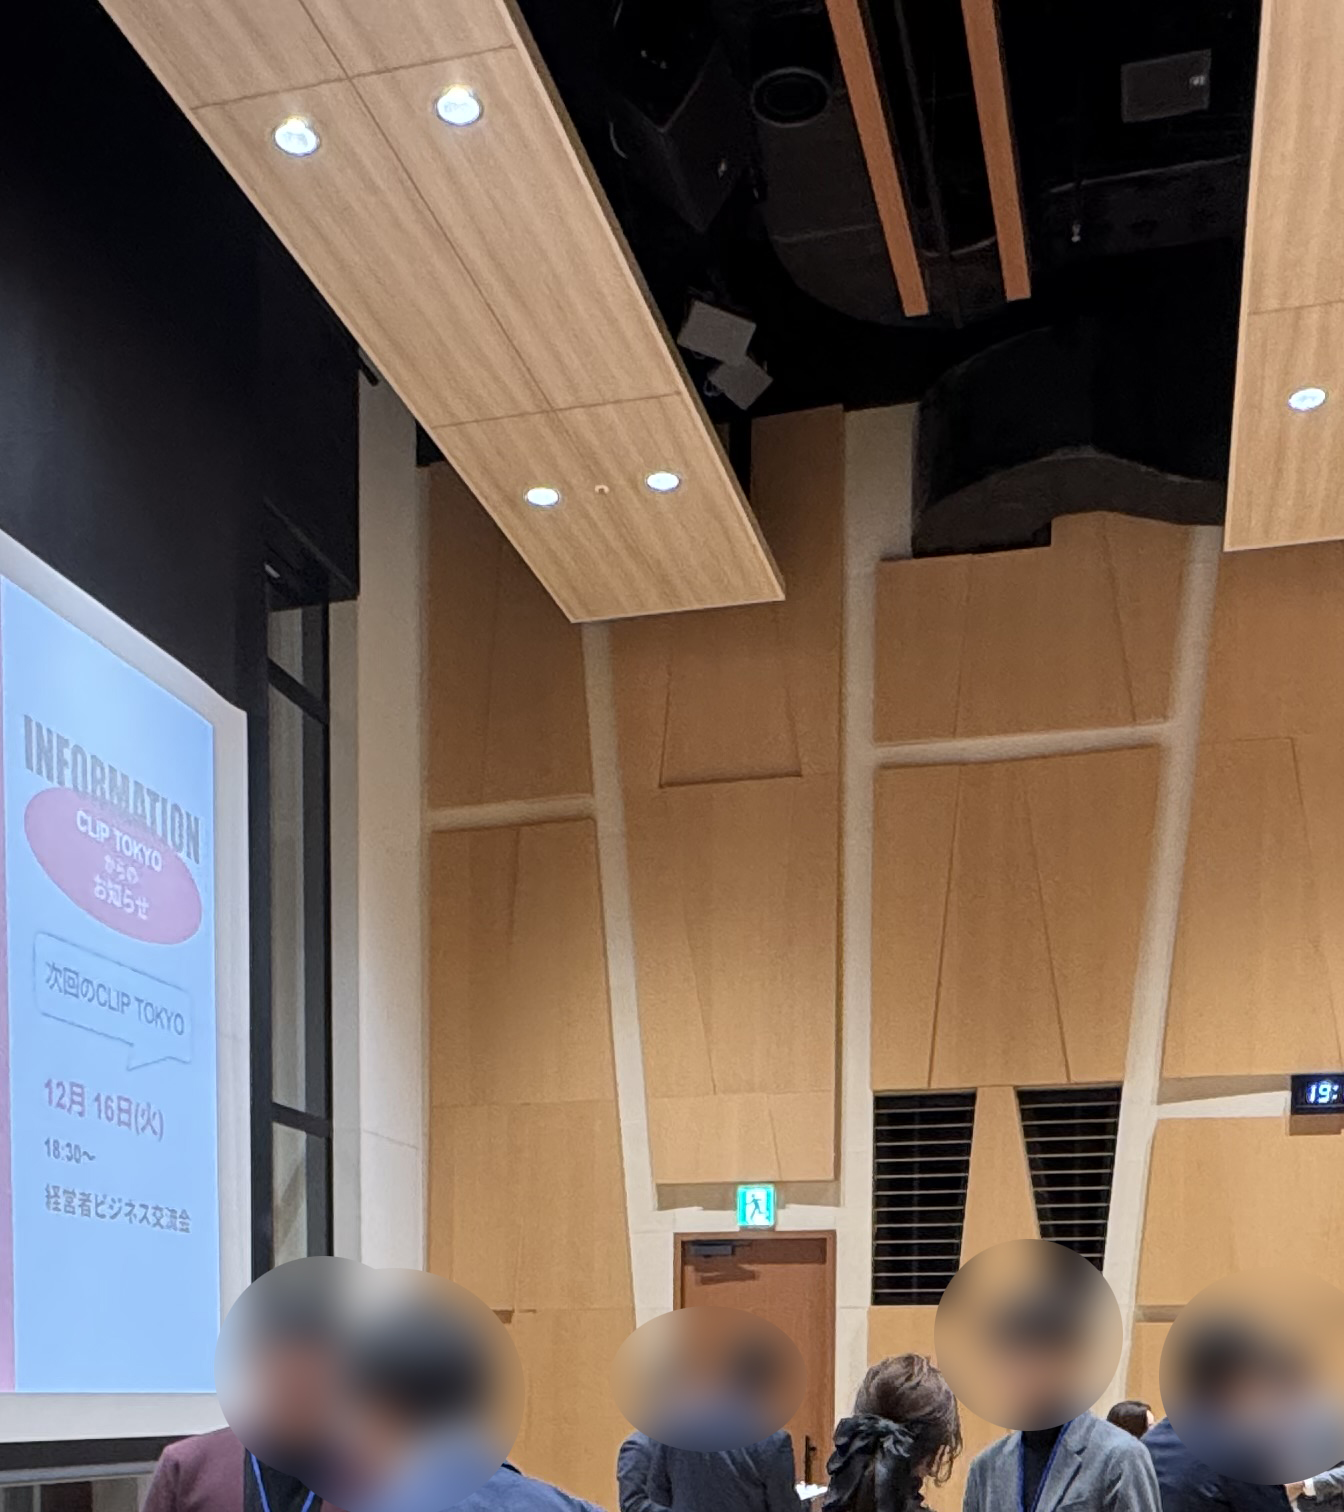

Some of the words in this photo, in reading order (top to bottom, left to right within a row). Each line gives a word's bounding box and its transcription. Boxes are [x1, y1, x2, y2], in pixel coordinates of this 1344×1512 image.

[24, 714, 199, 864] INFORMATION
[76, 810, 110, 842] CLIP
[114, 830, 162, 872] TOKYO
[93, 874, 150, 920] お知らせ
[104, 855, 139, 885] からの
[45, 961, 131, 1014] 次回のCLIP
[134, 997, 185, 1036] TOKYO
[44, 1078, 86, 1118] 12月
